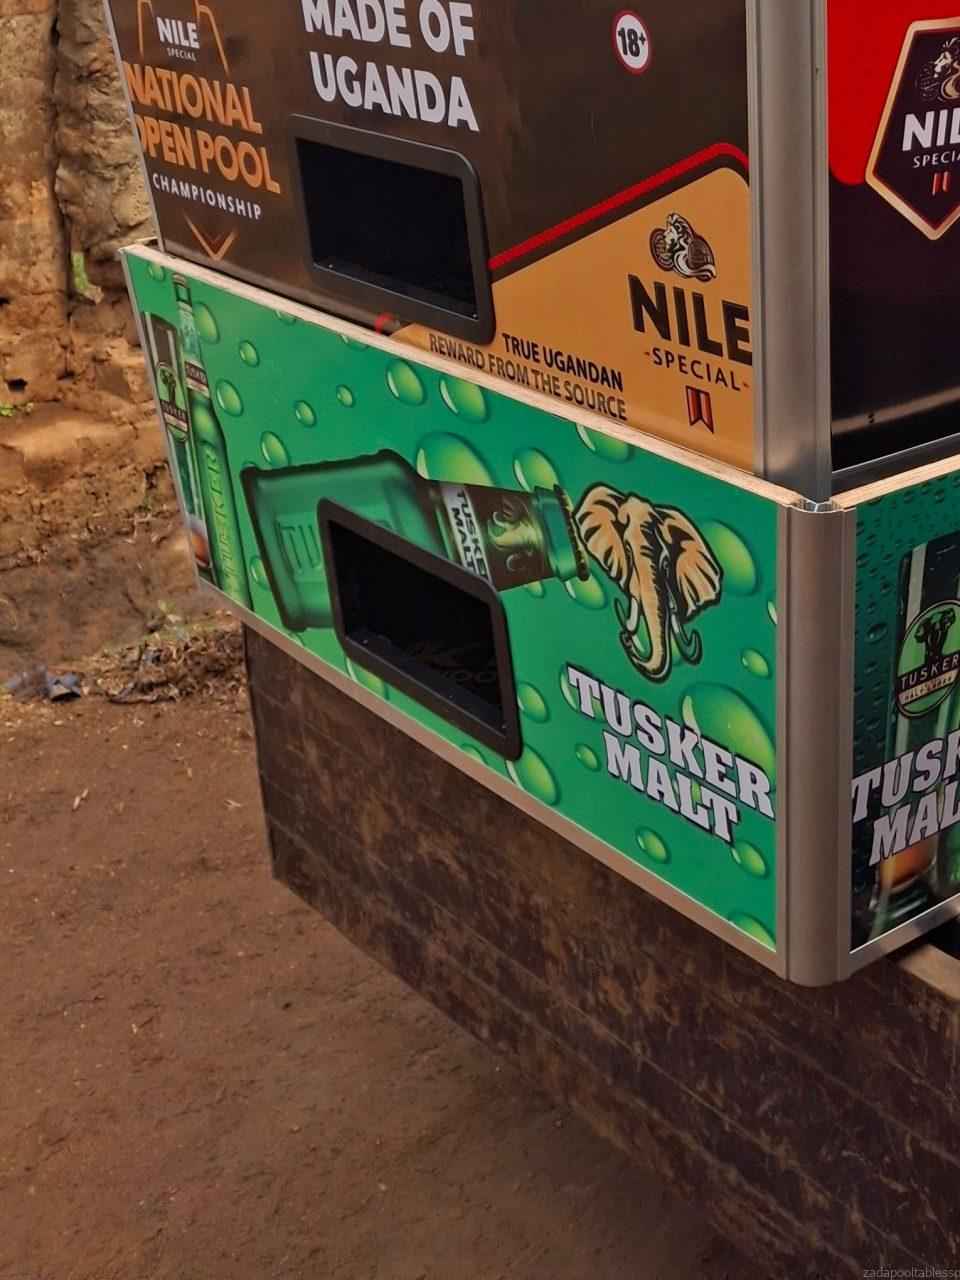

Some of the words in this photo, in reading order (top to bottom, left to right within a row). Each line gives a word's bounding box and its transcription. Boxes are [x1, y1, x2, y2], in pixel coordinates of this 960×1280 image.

[156, 16, 200, 50] NILE
[167, 47, 196, 62] SPECIAL
[617, 26, 646, 58] 18+
[122, 60, 263, 135] NATIONAL
[309, 50, 481, 132] UGANDA
[196, 130, 281, 195] POOL
[152, 173, 262, 221] CHAMPIONSHIP
[628, 274, 752, 366] NILE
[429, 332, 485, 369] REWARD
[488, 353, 531, 386] FROM
[529, 366, 562, 397] THE
[564, 380, 628, 421] SOURCE
[502, 333, 541, 363] TRUE
[543, 346, 623, 392] UGANDAN
[653, 350, 741, 390] SPECIAL
[457, 489, 489, 580] TUSKE
[901, 654, 960, 690] TUSKER
[566, 666, 776, 820] TUSKER
[603, 732, 741, 844] MALT
